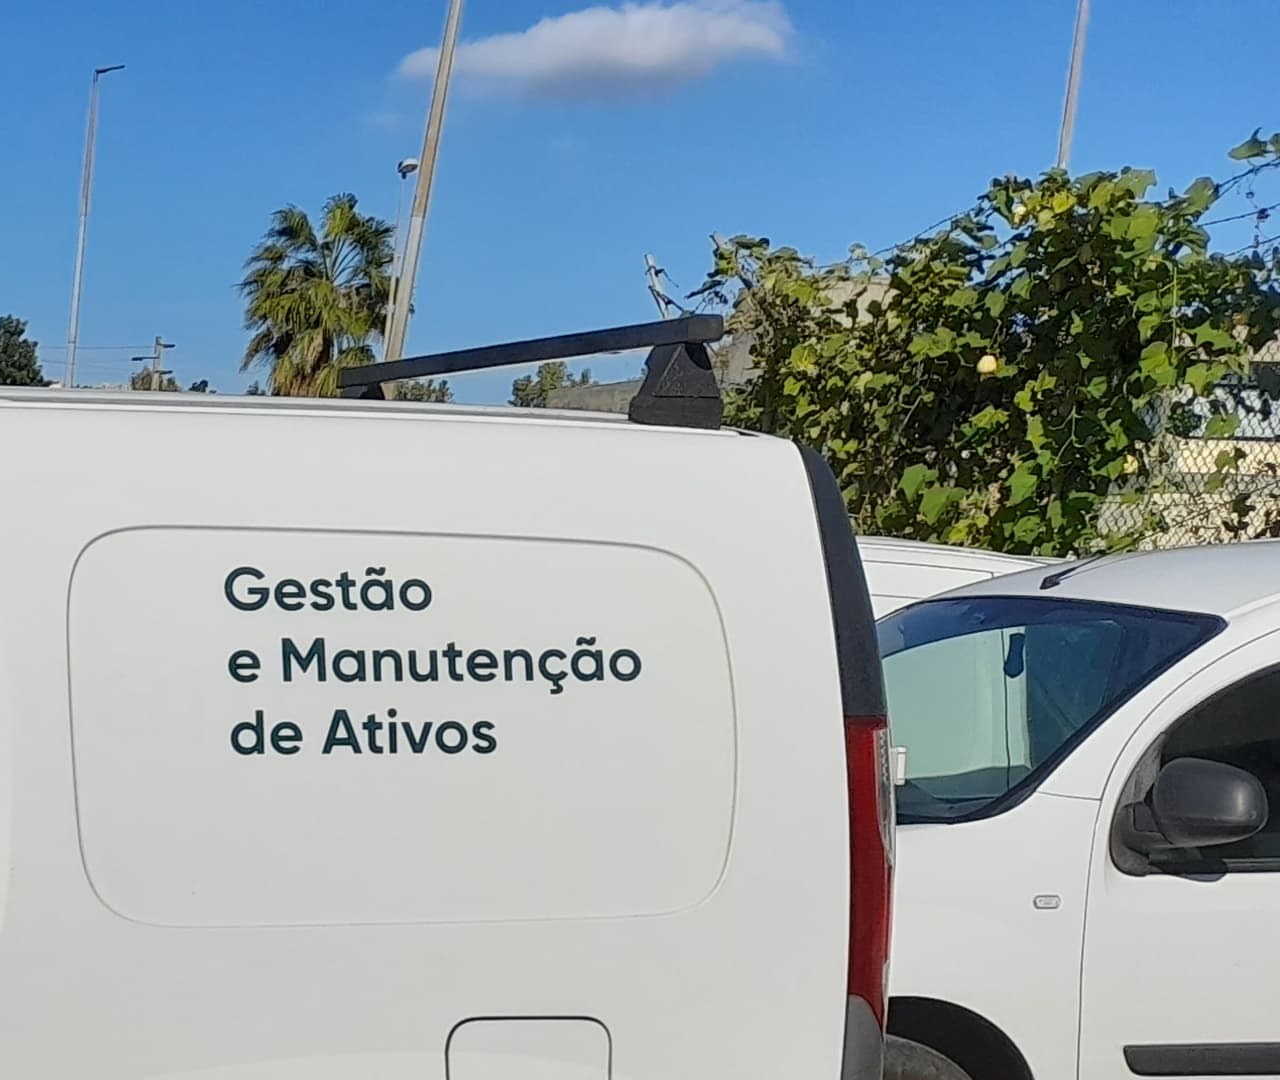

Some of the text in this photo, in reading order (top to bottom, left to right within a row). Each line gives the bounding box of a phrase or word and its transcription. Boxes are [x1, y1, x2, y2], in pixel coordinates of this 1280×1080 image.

[224, 566, 433, 611] Gestão
[228, 637, 642, 695] e Manutenção
[230, 708, 497, 755] de Ativos
